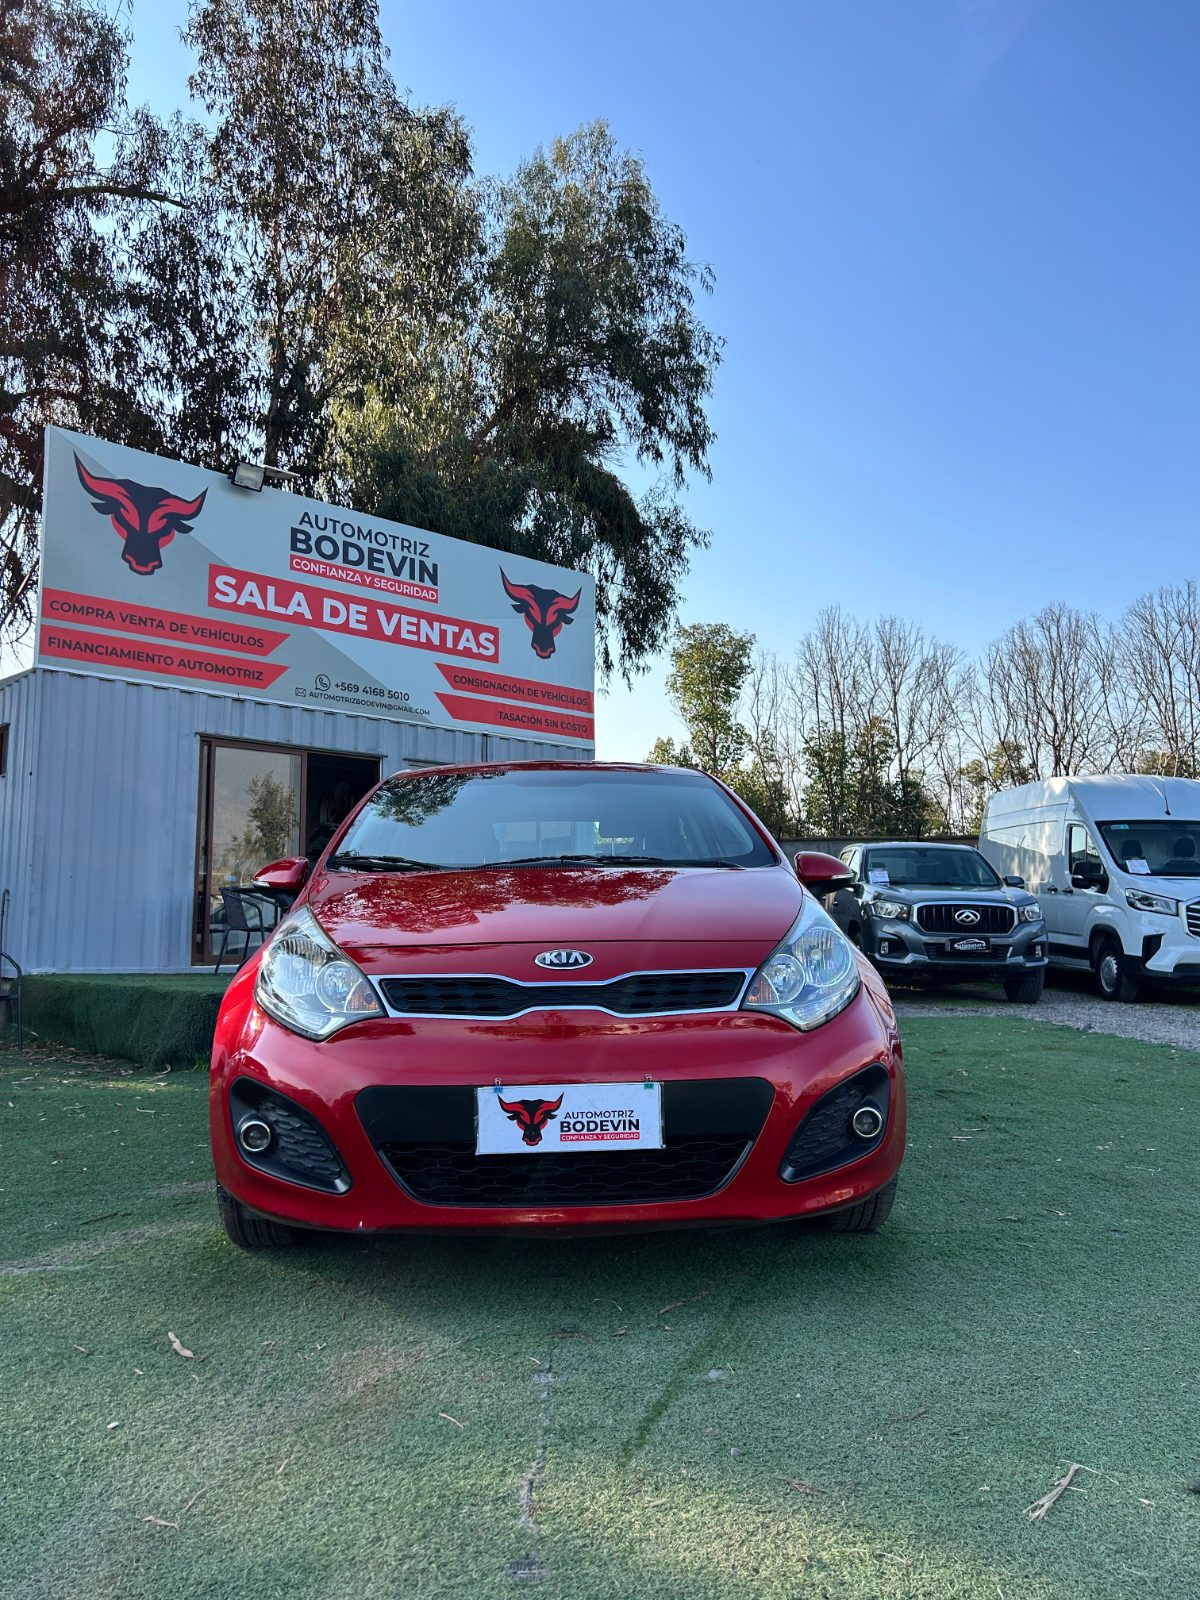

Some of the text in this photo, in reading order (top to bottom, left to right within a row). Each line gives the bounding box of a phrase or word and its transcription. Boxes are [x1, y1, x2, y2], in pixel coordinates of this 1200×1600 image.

[298, 511, 430, 558] AUTOMOTRIZ
[290, 526, 439, 587] BODEVIN
[292, 558, 437, 601] CONFIANZA Y SEGURIDAD
[50, 599, 265, 649] COMPRA VENTA DE VEHÍCULOS
[214, 574, 496, 657] SALA DE VENTAS
[47, 636, 264, 681] FINANCIAMIENTO AUTOMOTRIZ
[308, 690, 430, 716] AUTOMOTRIZBODEVIN@GMAIL.COM
[334, 682, 410, 702] +569 4168 5010
[453, 674, 588, 707] CONSIGNACIÓN DE VEHÍCULOS
[497, 710, 588, 734] TASACIÓN SIN COSTO
[544, 950, 585, 965] KIA
[560, 1119, 640, 1133] BODEVIN
[564, 1109, 635, 1120] AUTOMOTRIZ
